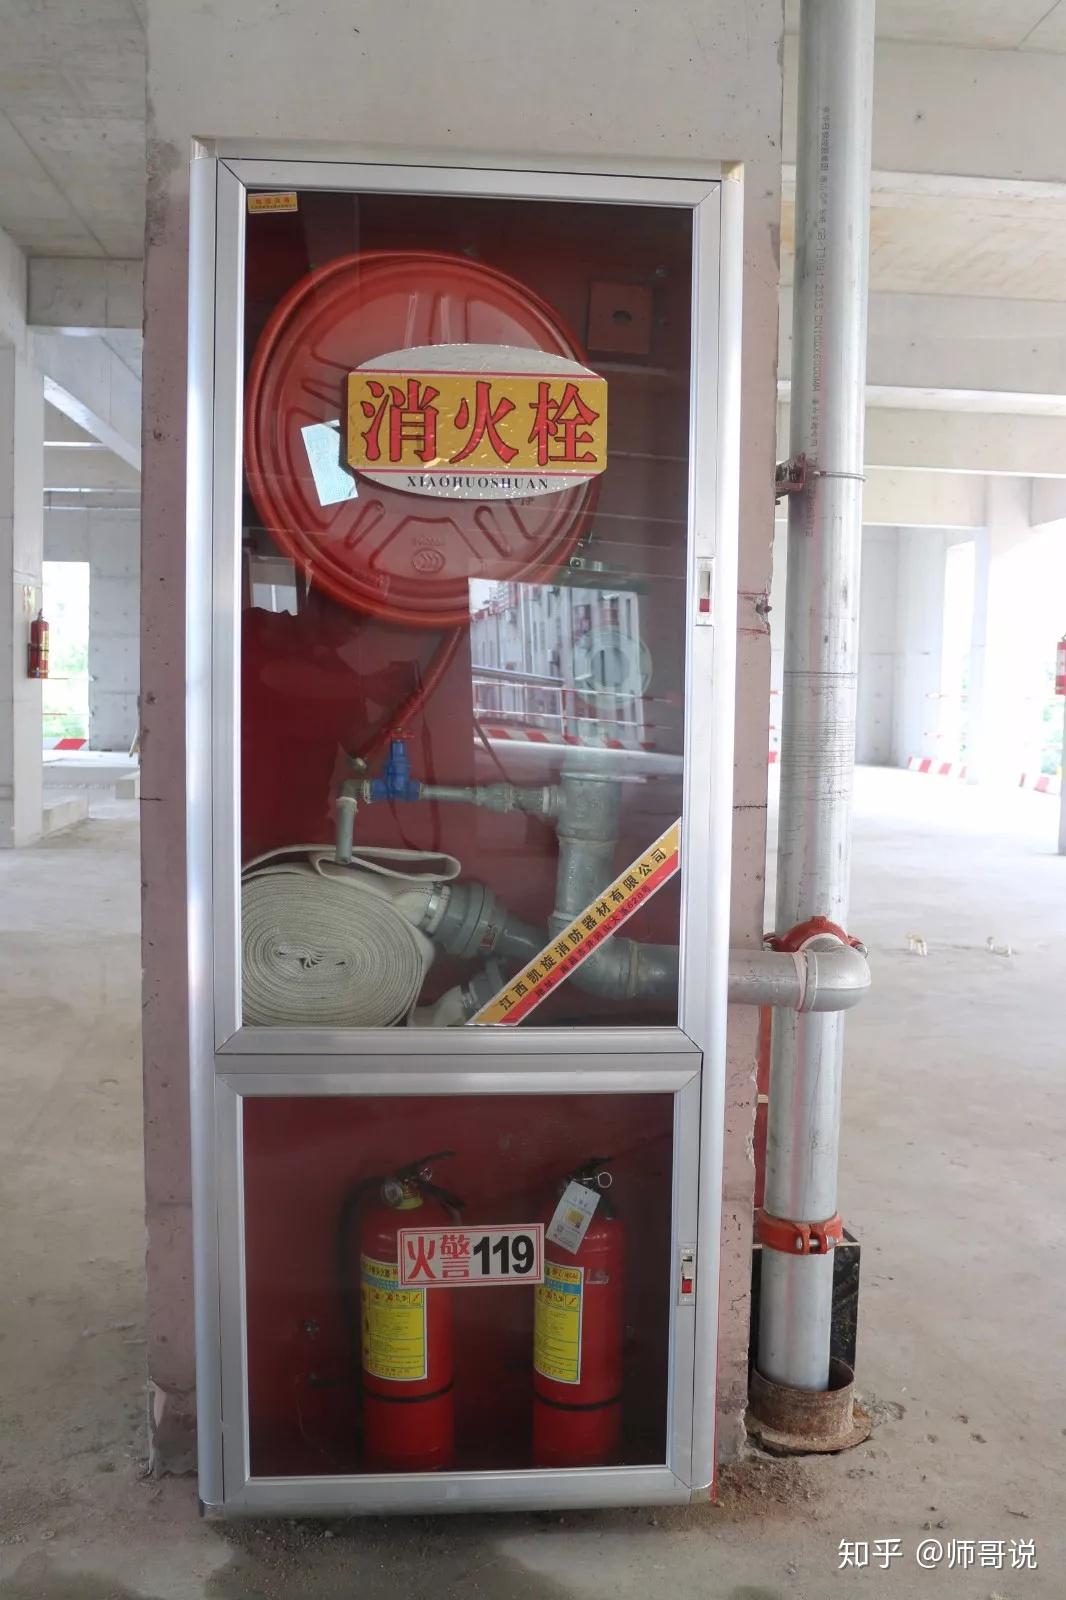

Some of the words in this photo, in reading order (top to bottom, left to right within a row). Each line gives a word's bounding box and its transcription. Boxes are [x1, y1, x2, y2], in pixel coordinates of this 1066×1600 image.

[360, 378, 600, 466] 消火栓
[407, 475, 549, 490] XIAOHUOSHUAN
[498, 848, 667, 1011] 江西凯旋消防器材有限公司
